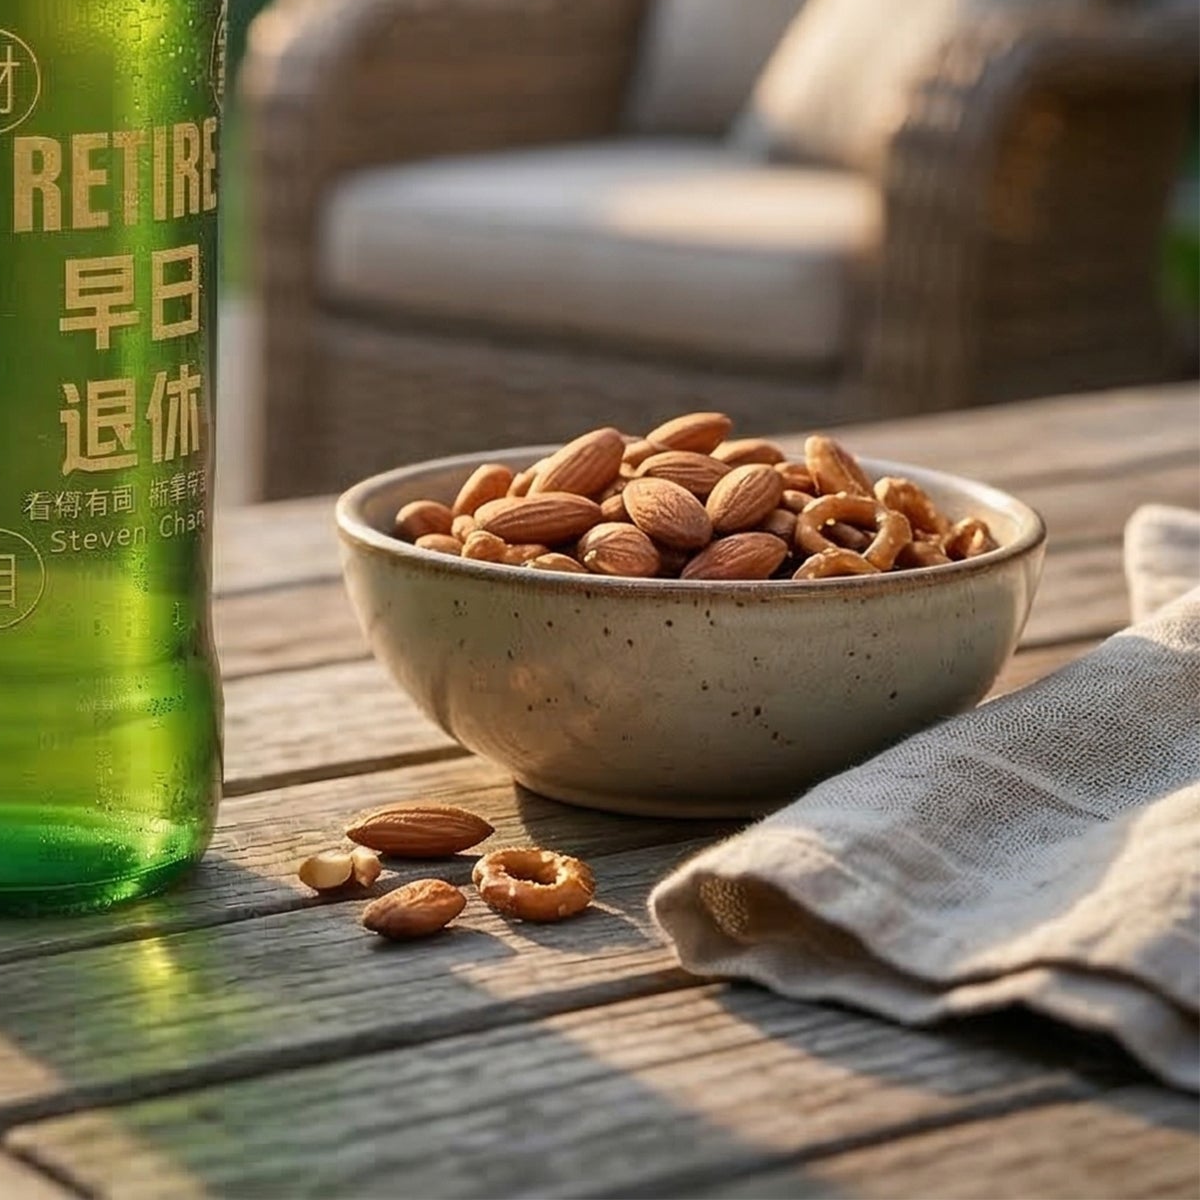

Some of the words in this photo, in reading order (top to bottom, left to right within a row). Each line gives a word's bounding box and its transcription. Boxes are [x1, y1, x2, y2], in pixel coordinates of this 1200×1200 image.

[13, 116, 218, 234] RETIRE
[59, 243, 200, 351] 早日
[59, 363, 201, 477] 退休
[50, 526, 146, 553] Steven
